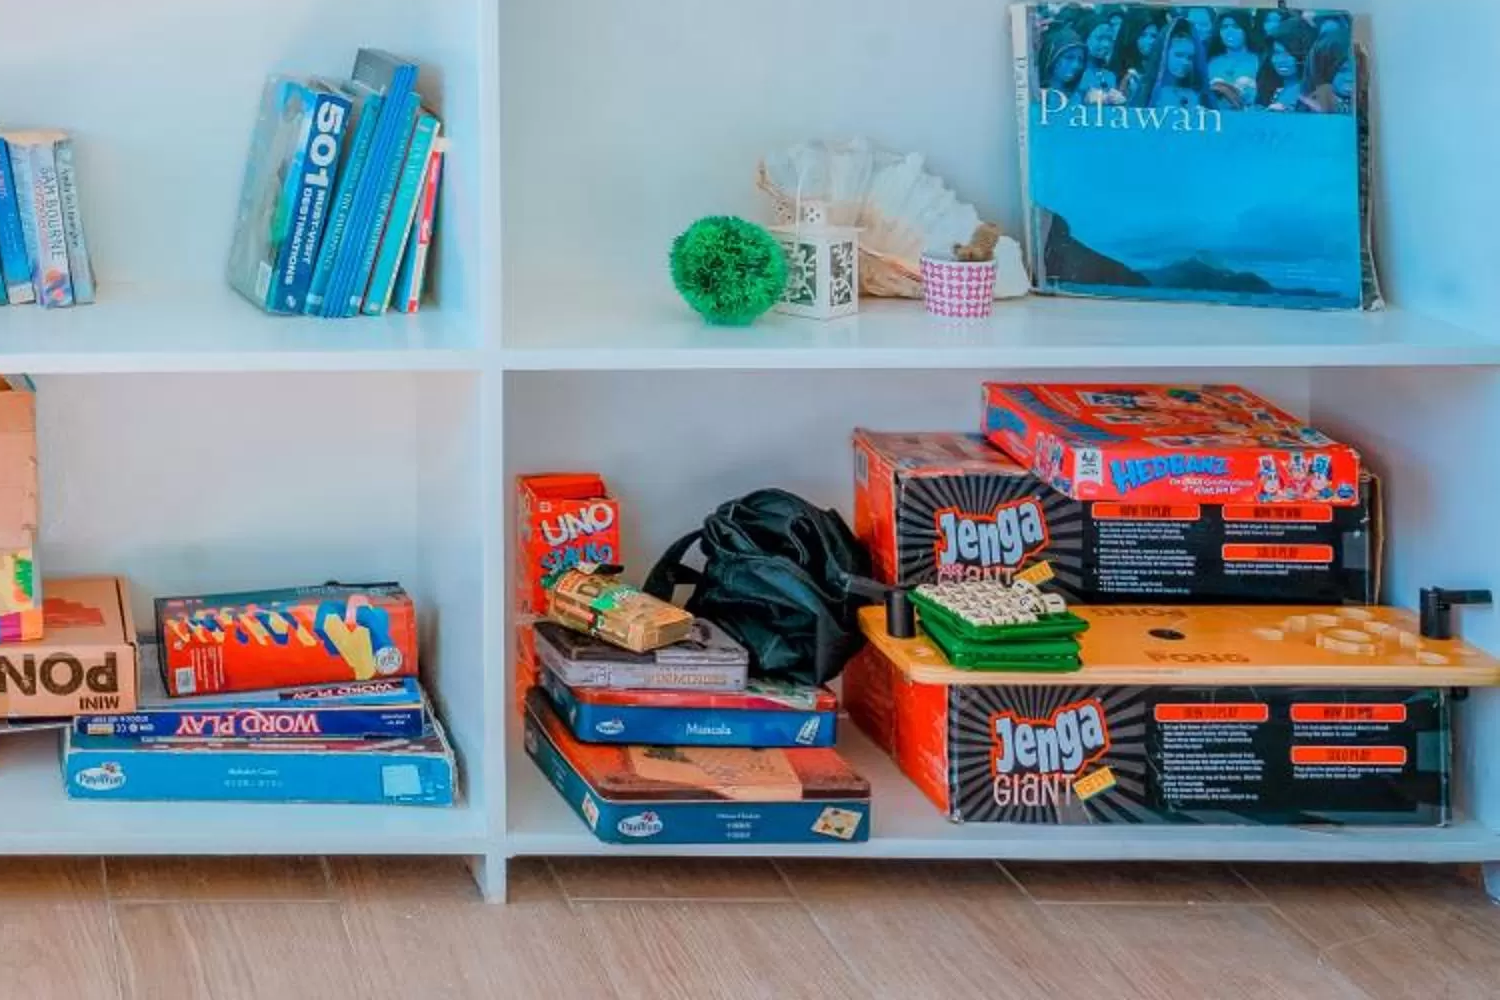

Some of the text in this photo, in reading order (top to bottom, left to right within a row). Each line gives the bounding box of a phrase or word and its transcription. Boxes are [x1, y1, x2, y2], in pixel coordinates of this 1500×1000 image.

[1039, 88, 1222, 133] Palawan
[310, 101, 345, 187] 501
[44, 198, 65, 260] BOURNE
[285, 187, 312, 285] DESTINATIONS
[302, 189, 326, 265] MUST-VISIT
[1110, 454, 1229, 495] HEDBANZ
[541, 503, 613, 547] UNO
[939, 502, 1045, 566] Jenga
[79, 696, 120, 711] MINI
[176, 713, 235, 734] PLAY
[241, 710, 321, 734] WORD
[995, 705, 1105, 772] Jenga
